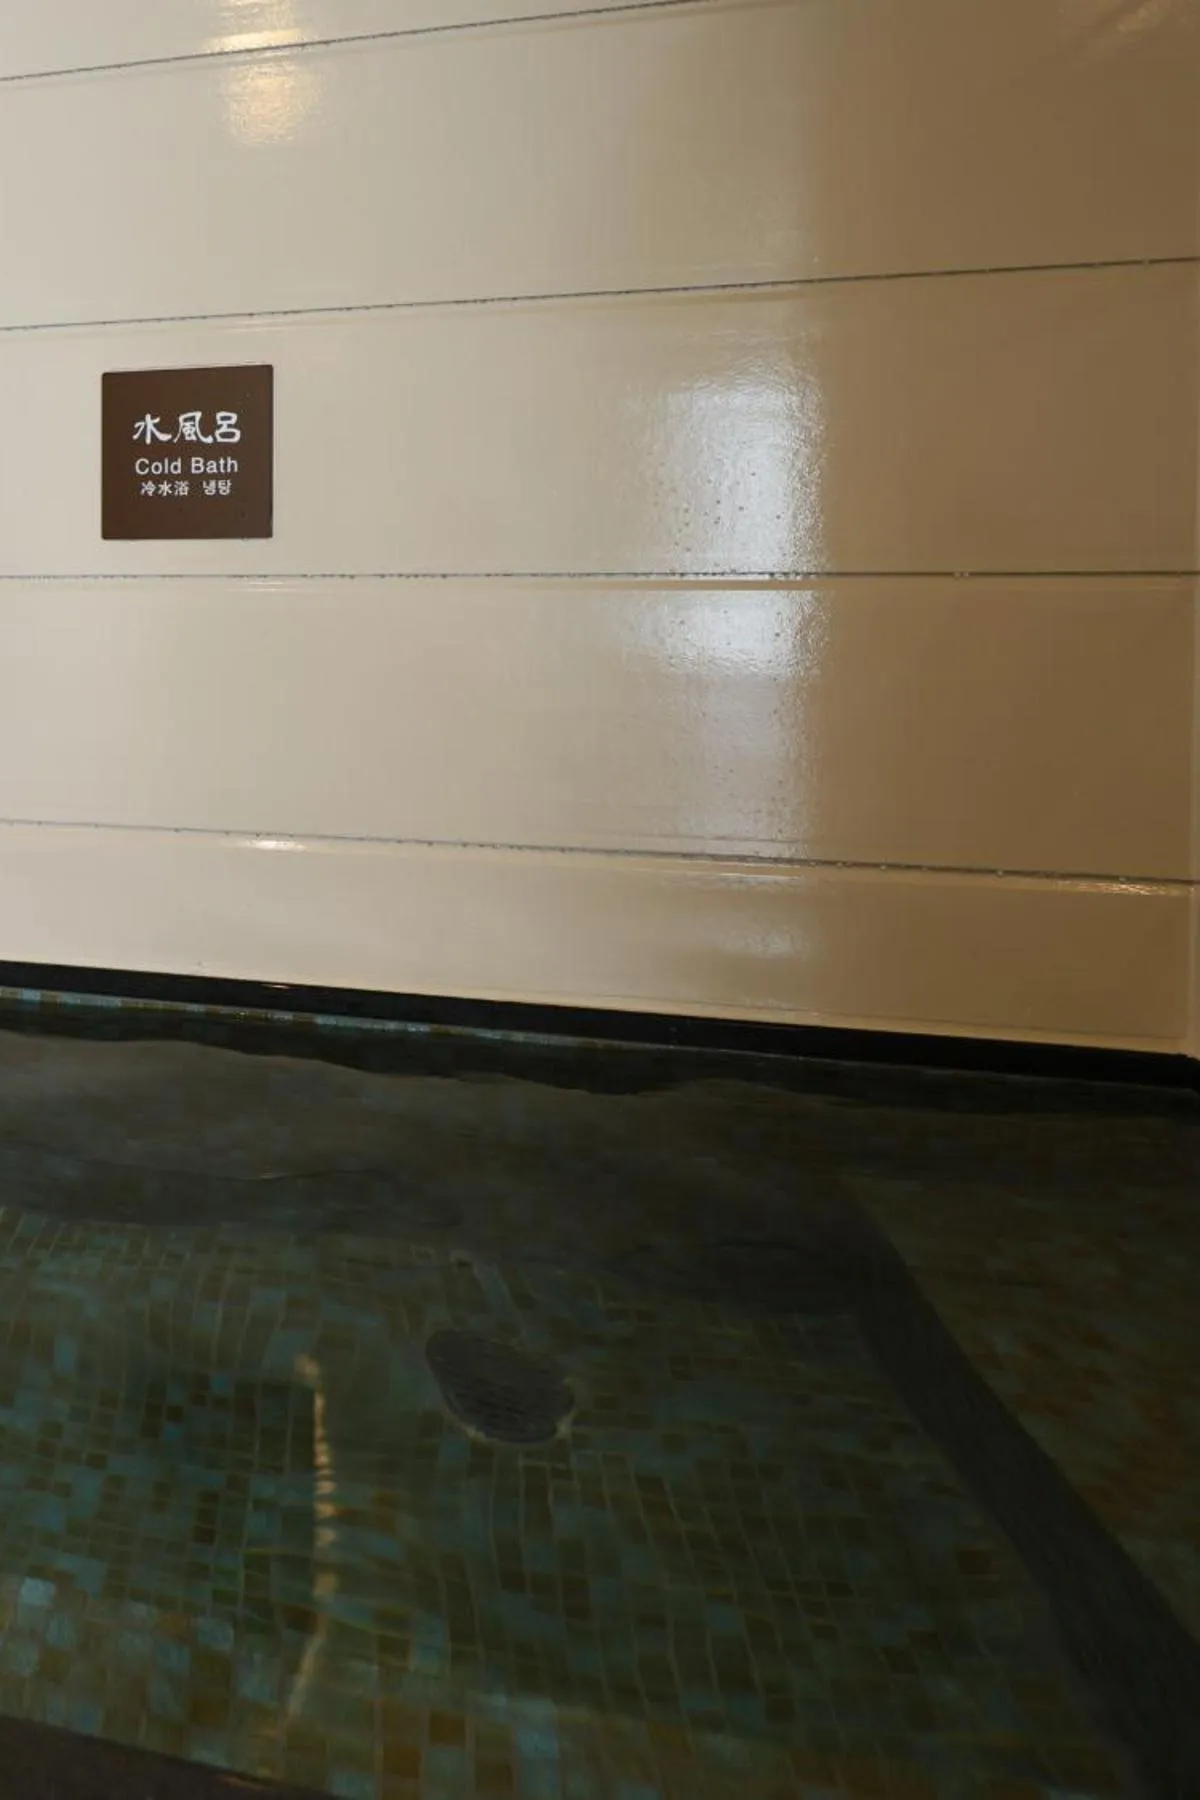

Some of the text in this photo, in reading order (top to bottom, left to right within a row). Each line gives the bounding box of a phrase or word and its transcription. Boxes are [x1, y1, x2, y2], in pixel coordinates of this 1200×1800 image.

[132, 410, 241, 445] 水風呂
[135, 456, 238, 475] Cold Bath
[140, 480, 189, 497] 冷水浴
[202, 479, 232, 496] 냉탕
